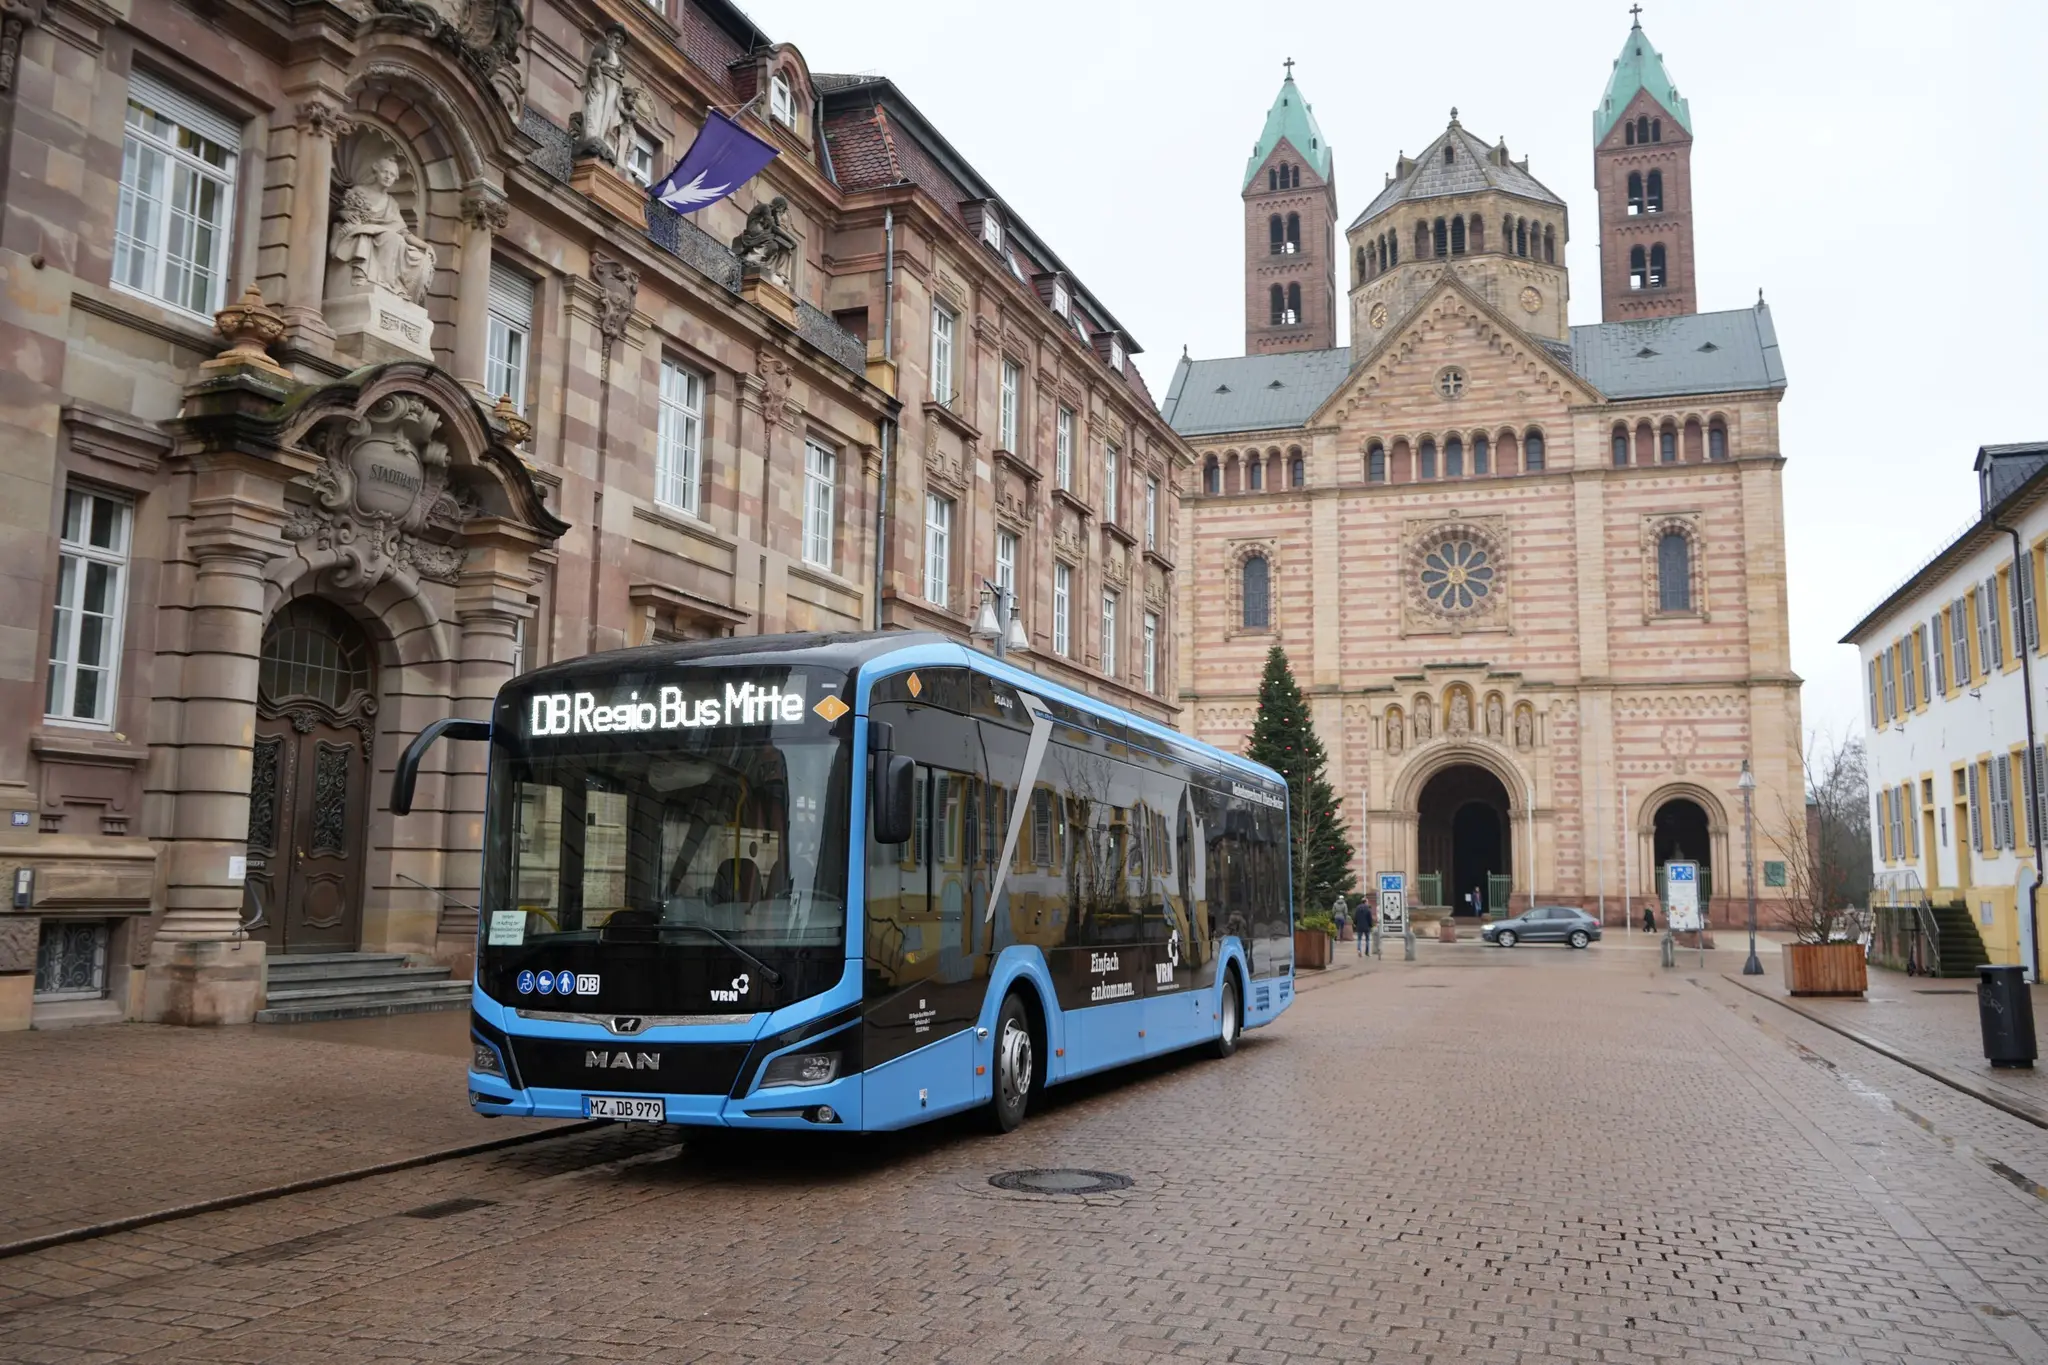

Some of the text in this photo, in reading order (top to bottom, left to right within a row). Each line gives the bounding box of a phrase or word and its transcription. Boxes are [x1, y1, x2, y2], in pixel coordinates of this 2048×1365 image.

[369, 464, 421, 493] STADTHAUS
[531, 681, 804, 735] DB Regio Bus Mitte
[1091, 952, 1119, 976] Einfach
[1155, 962, 1173, 984] VRN
[579, 977, 598, 992] DB
[1091, 981, 1135, 1001] ankommen.
[710, 990, 738, 1002] VRN
[585, 1051, 660, 1070] MAN
[590, 1100, 661, 1118] MZ DB 979
